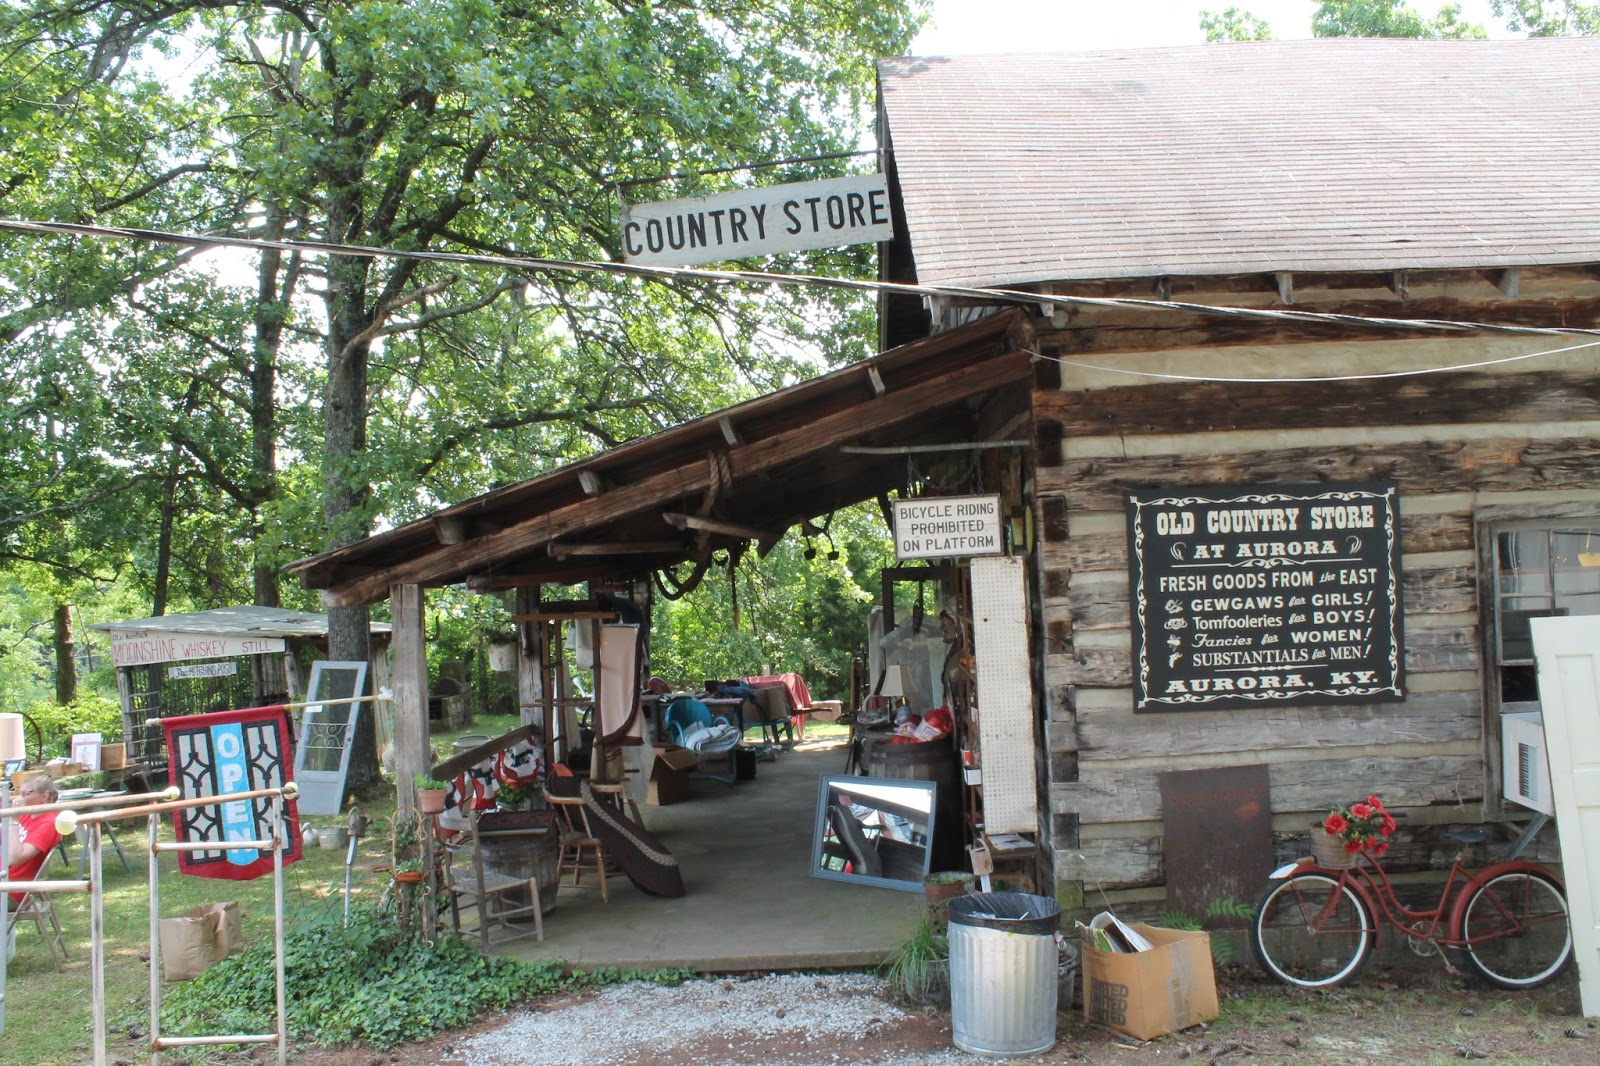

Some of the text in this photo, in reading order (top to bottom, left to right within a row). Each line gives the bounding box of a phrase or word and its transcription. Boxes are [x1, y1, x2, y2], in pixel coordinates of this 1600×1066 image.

[624, 189, 889, 256] COUNTRY STORE
[900, 503, 994, 520] BICYCLE RIDING
[1156, 505, 1374, 536] OLD COUNTRY STORE
[911, 520, 985, 536] PROHIBITED
[903, 535, 994, 553] ON PLATFORM
[1193, 540, 1338, 559] AT AURORA
[1160, 568, 1378, 592] FRESH GOODS FROM the EAST
[1191, 591, 1373, 612] GEWGAWS for GIRLS!
[1193, 608, 1376, 630] Tomfooleries for BOYS!
[1191, 628, 1373, 647] Fancies for WOMEN!
[113, 638, 272, 665] MOONSHINE WHISKEY STILL
[1192, 645, 1372, 667] SUBSTANTIALS for MEN!
[1165, 671, 1379, 693] AURORA, KY.
[216, 732, 254, 855] OPEN
